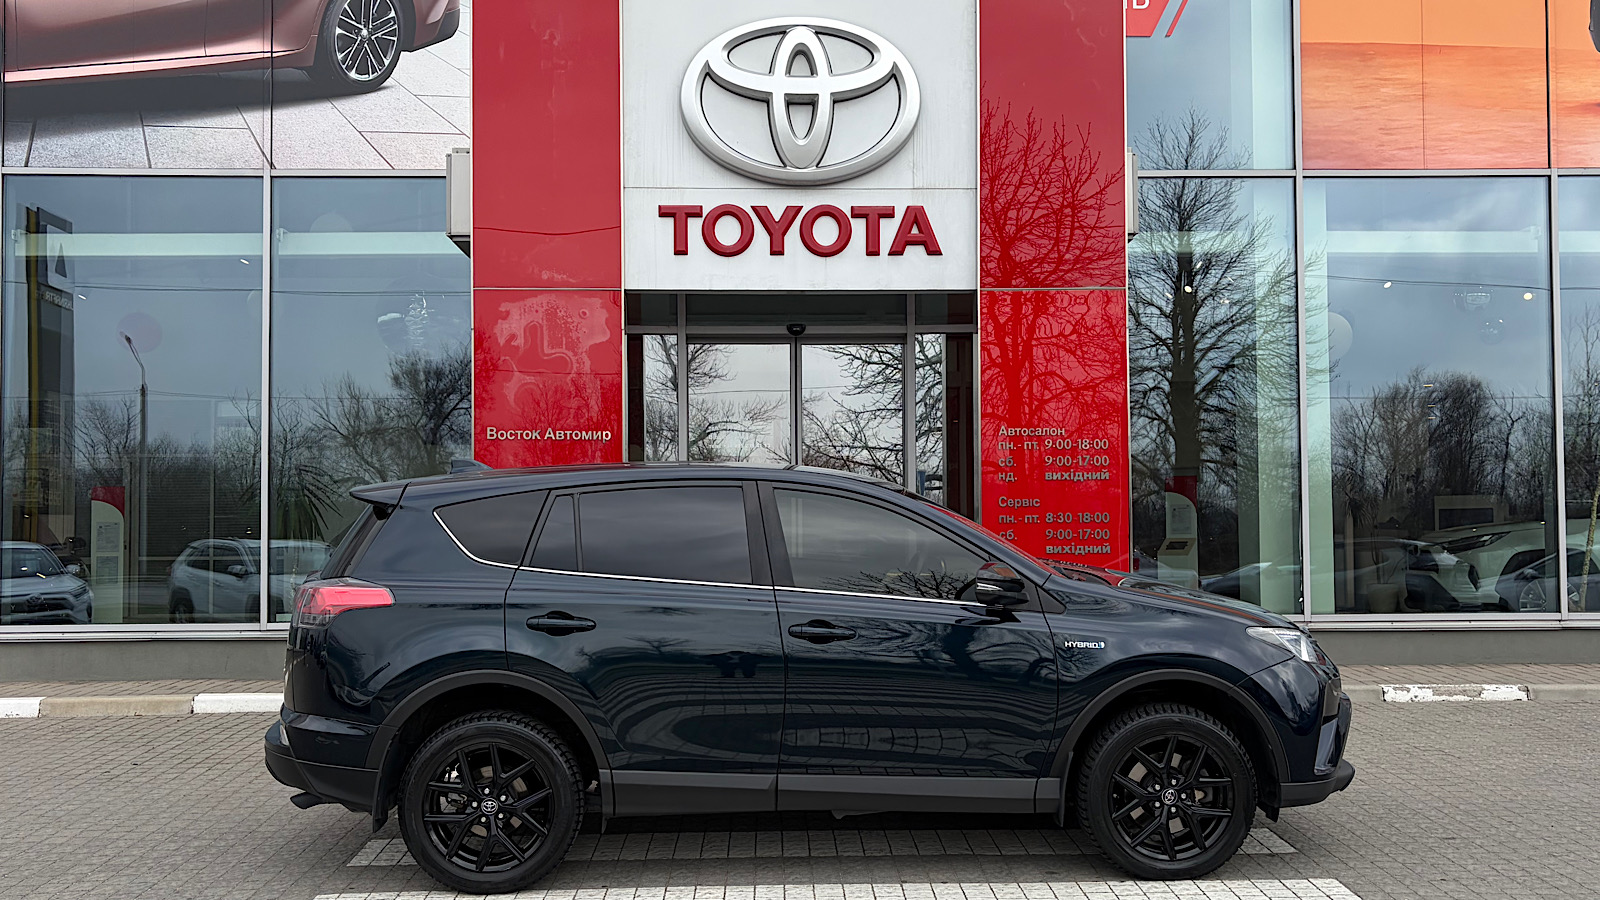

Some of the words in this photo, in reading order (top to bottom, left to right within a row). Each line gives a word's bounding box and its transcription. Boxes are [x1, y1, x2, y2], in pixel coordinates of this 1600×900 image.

[659, 203, 943, 257] TOYOTA
[487, 427, 541, 440] Восток
[544, 427, 611, 443] Автомир
[998, 425, 1065, 436] Автосалон
[998, 456, 1017, 467] сб.
[1044, 455, 1110, 466] 9:00-17:00
[998, 472, 1018, 482] нд.
[1045, 469, 1110, 482] вихідний
[998, 496, 1041, 509] Сервіс
[1045, 529, 1110, 540] 9:00-17:00
[1045, 542, 1111, 556] вихідний
